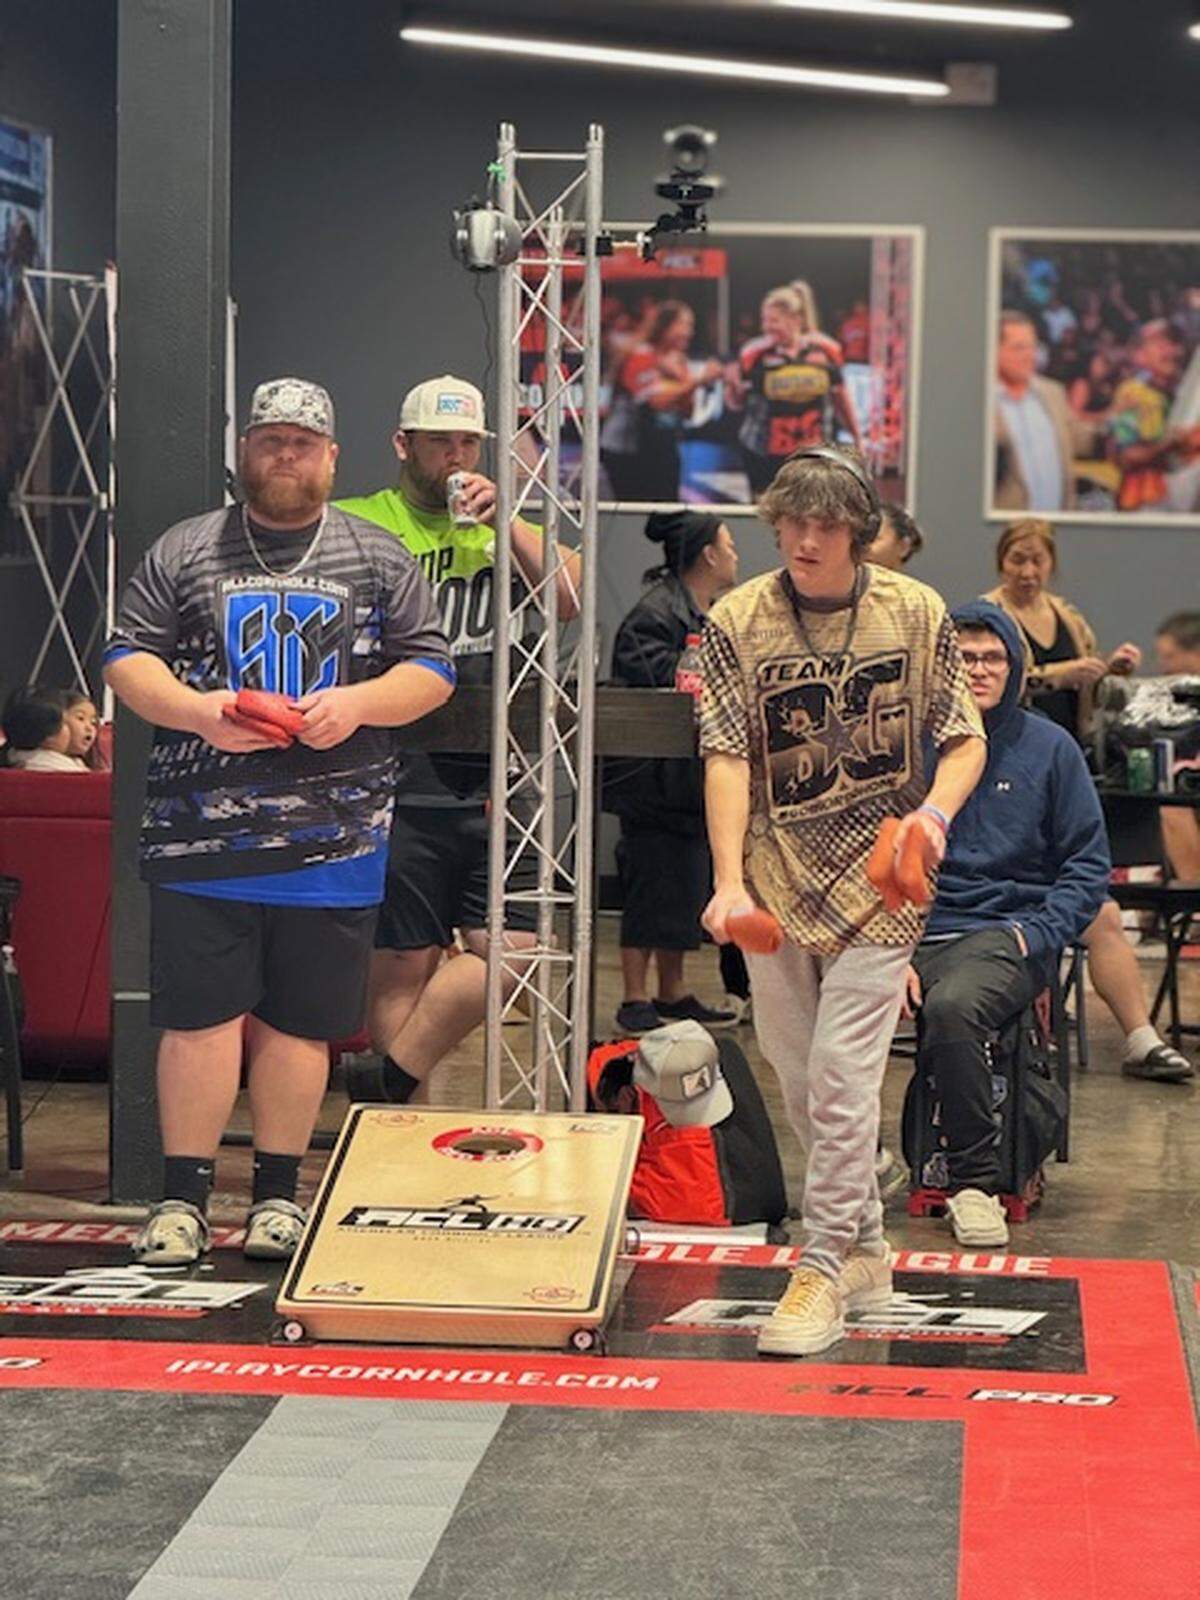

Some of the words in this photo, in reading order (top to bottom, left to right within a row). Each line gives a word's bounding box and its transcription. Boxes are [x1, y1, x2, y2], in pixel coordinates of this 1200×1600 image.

[763, 658, 846, 682] TEAM
[353, 1209, 489, 1231] ACL
[164, 1359, 662, 1391] IPLAYCORNHOLE.COM
[967, 1387, 1120, 1407] PRO
